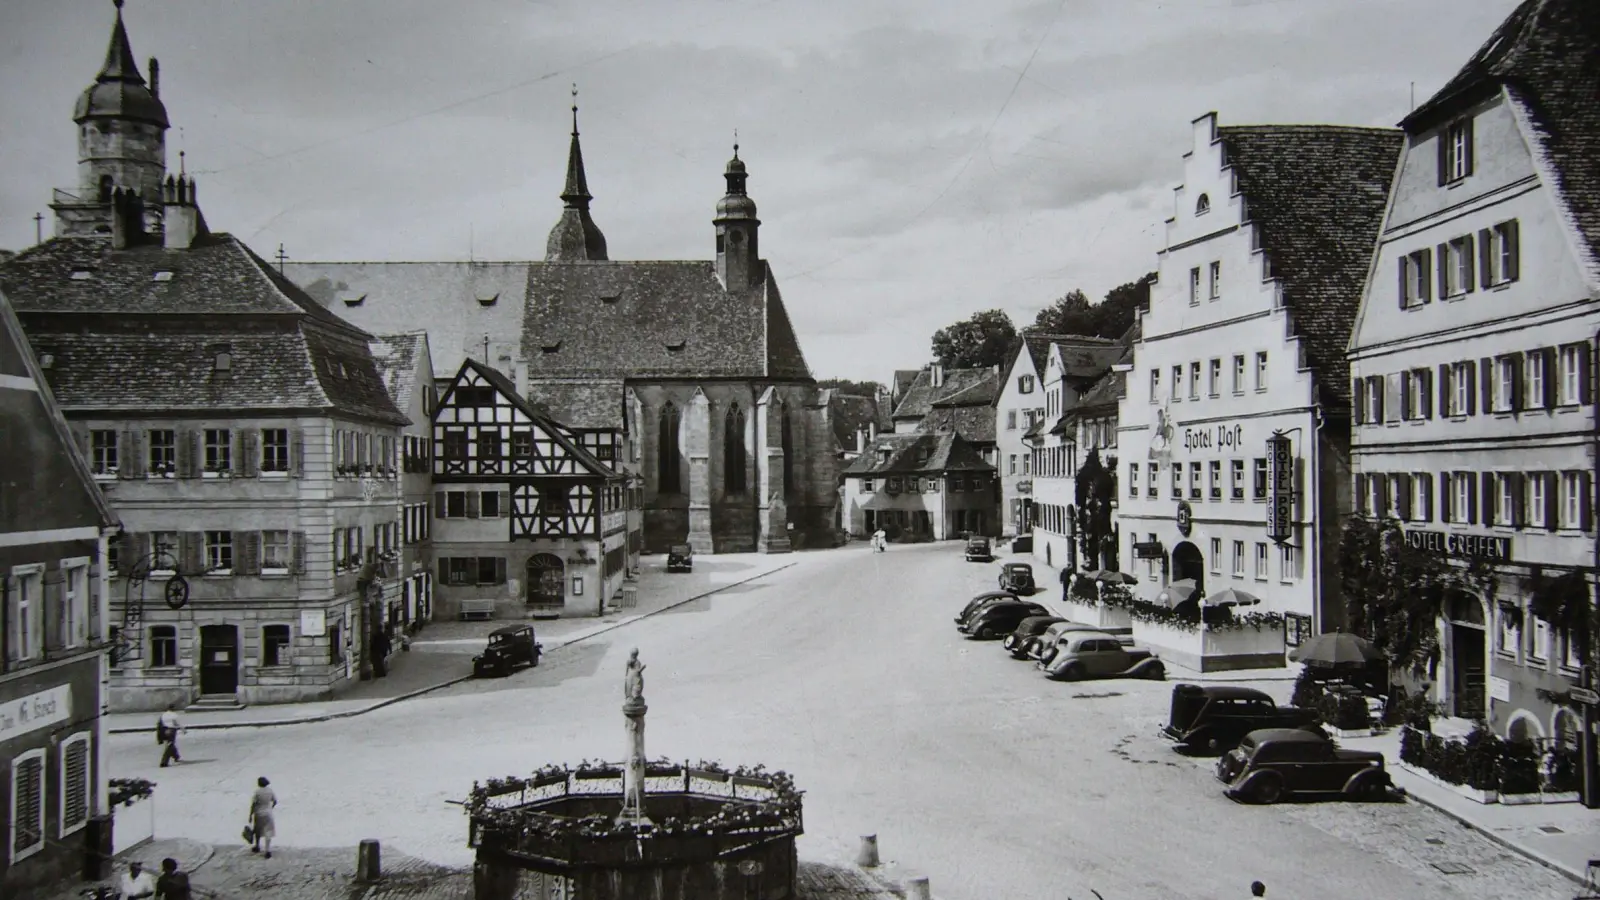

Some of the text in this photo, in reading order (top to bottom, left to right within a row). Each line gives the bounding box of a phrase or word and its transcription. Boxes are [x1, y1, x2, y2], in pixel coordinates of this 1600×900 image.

[1184, 428, 1212, 454] Hotel
[1277, 441, 1288, 535] HOTEL POST
[1404, 532, 1504, 557] HOTEL GREIFEN
